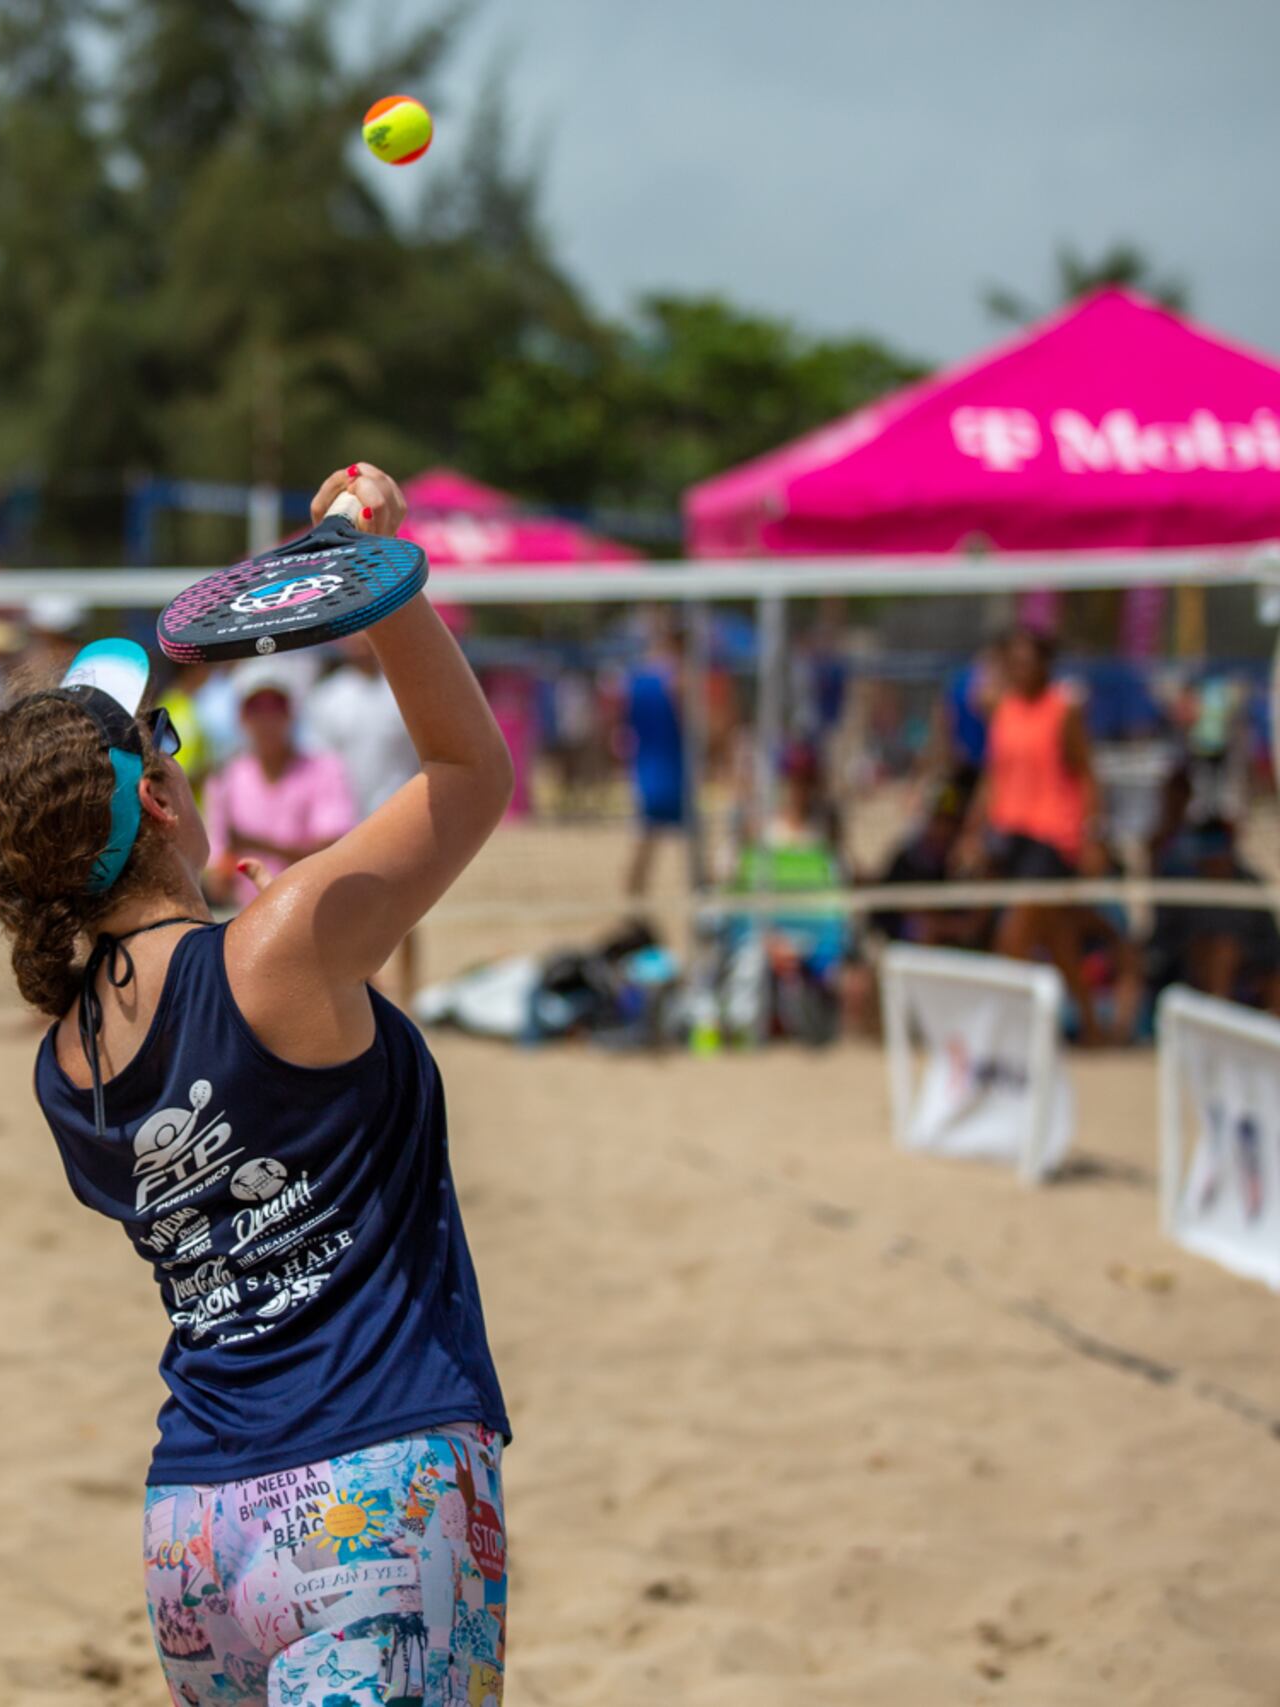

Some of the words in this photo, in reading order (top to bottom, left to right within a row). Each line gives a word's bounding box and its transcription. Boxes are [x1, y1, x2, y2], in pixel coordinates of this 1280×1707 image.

[135, 1121, 233, 1212] FTP
[155, 1183, 205, 1213] PUERTO
[204, 1164, 231, 1188] RICO
[245, 1230, 354, 1292] SAHALE
[256, 1470, 298, 1496] NEED
[304, 1464, 318, 1481] A
[294, 1479, 331, 1502] AND
[281, 1501, 322, 1525] TAN
[272, 1516, 325, 1546] BEAC
